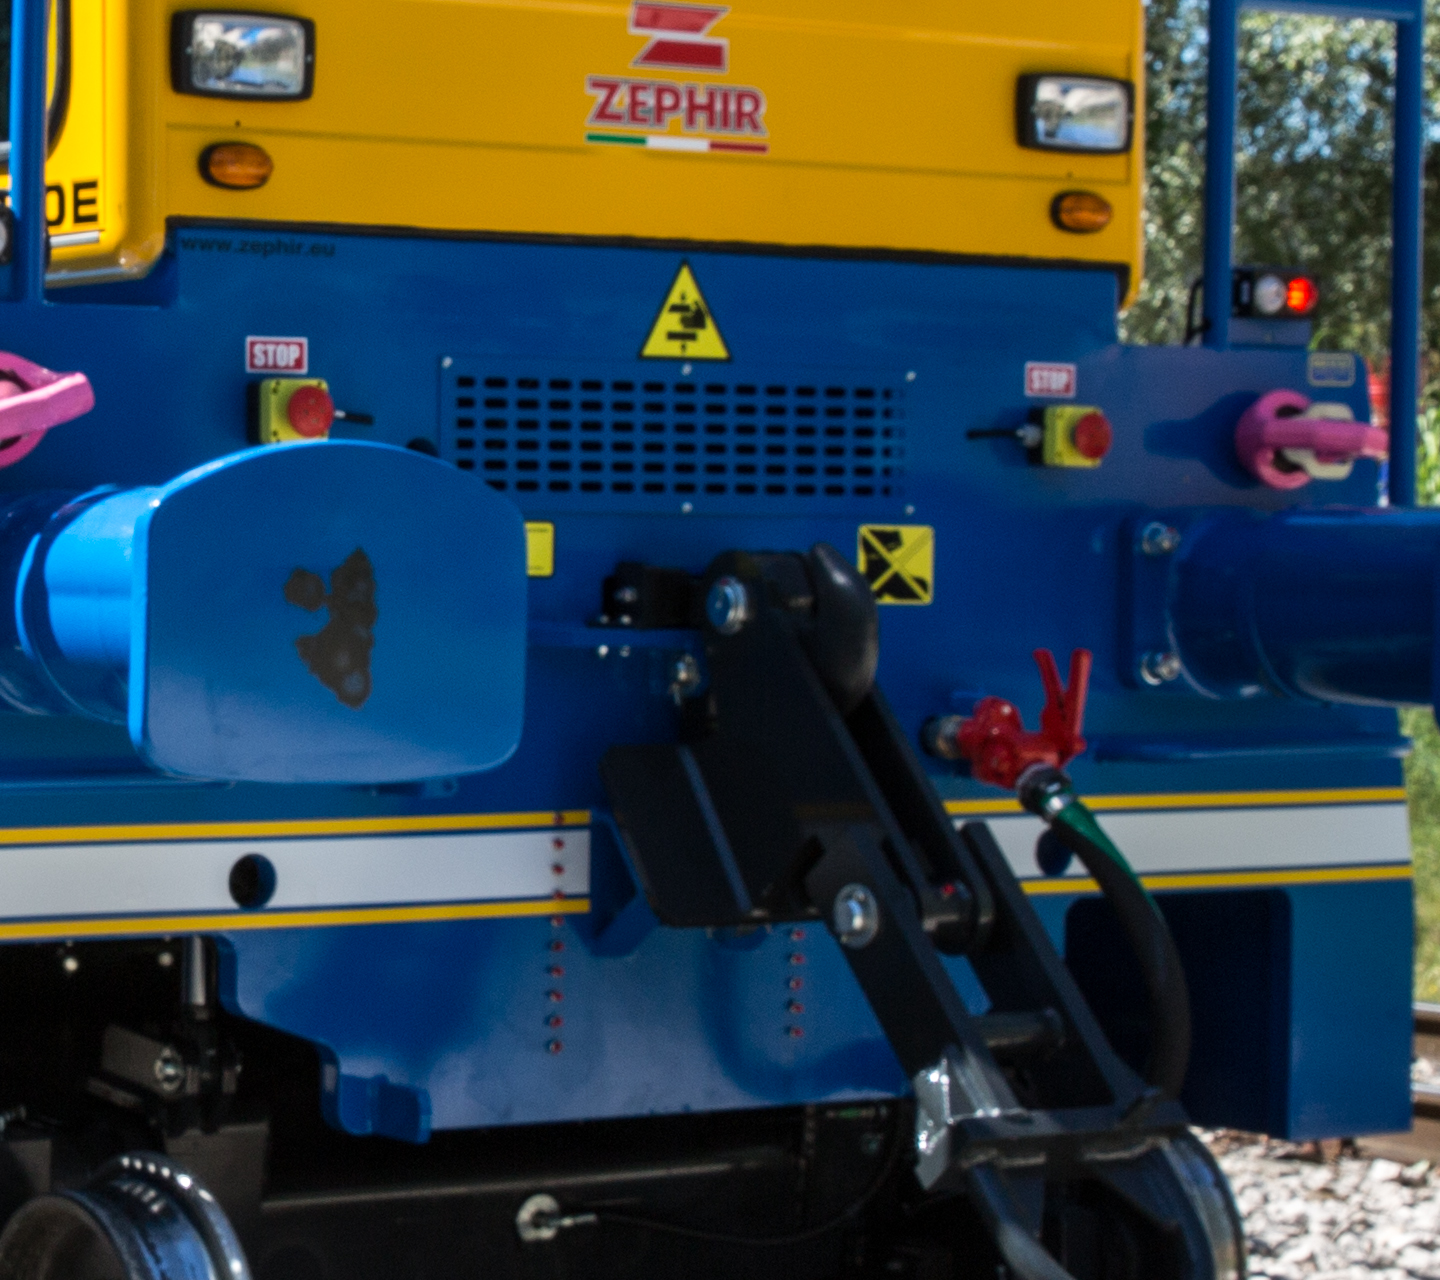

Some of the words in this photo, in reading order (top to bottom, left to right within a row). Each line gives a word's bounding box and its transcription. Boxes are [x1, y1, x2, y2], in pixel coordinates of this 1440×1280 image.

[585, 77, 766, 134] ZEPHIR
[180, 237, 336, 259] www.zephir.eu
[253, 342, 301, 367] STOP
[1031, 370, 1068, 390] STOP
